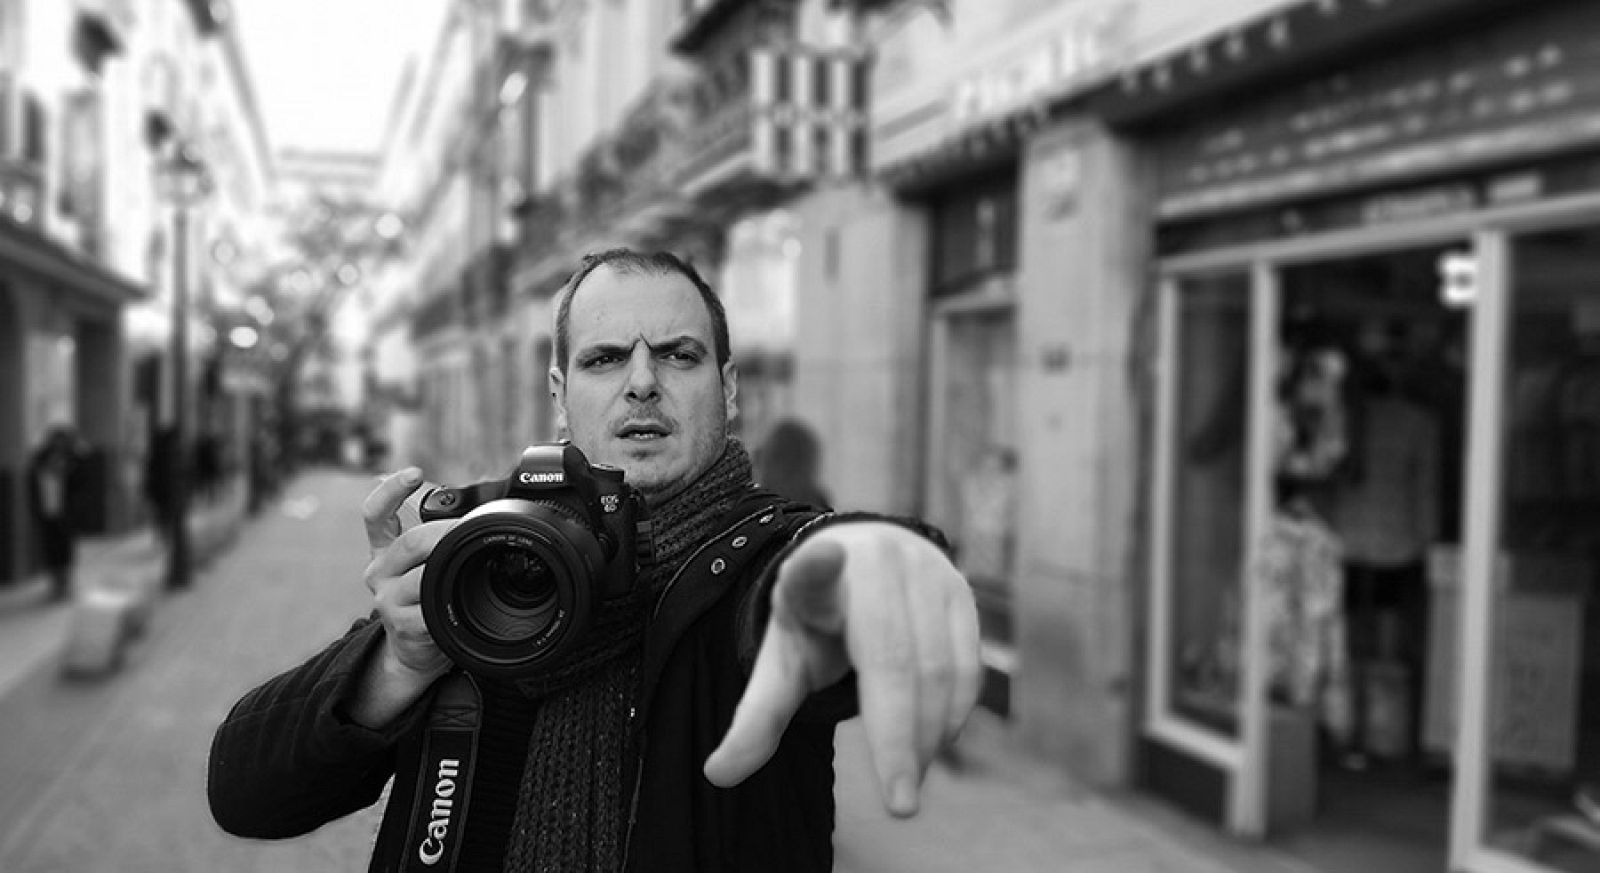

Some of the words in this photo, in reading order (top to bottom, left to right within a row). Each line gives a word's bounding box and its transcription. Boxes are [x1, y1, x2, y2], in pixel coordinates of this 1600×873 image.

[520, 472, 564, 483] Canon
[600, 495, 619, 504] EOS
[419, 759, 460, 865] Canon
